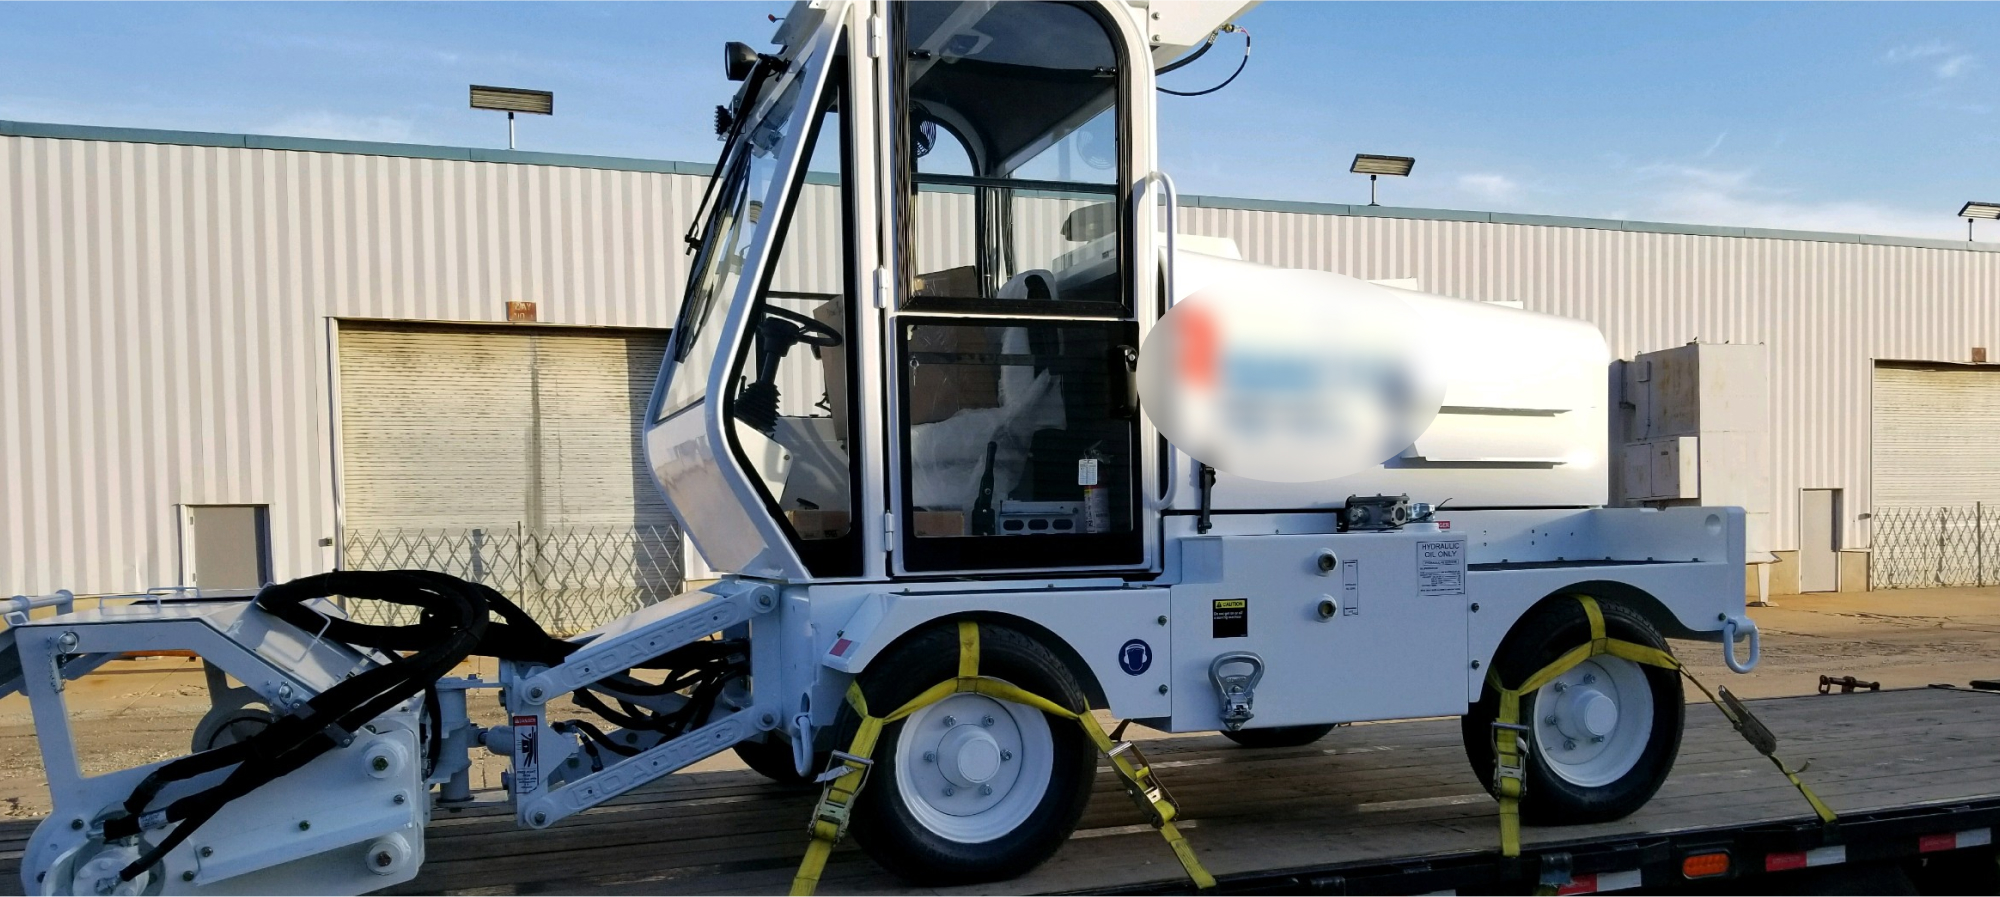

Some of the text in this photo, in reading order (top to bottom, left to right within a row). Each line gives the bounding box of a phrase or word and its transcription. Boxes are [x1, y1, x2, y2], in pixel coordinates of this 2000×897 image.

[1437, 550, 1457, 558] ONLY
[571, 608, 733, 684] ROADTEC
[573, 726, 735, 806] ROADTEC
